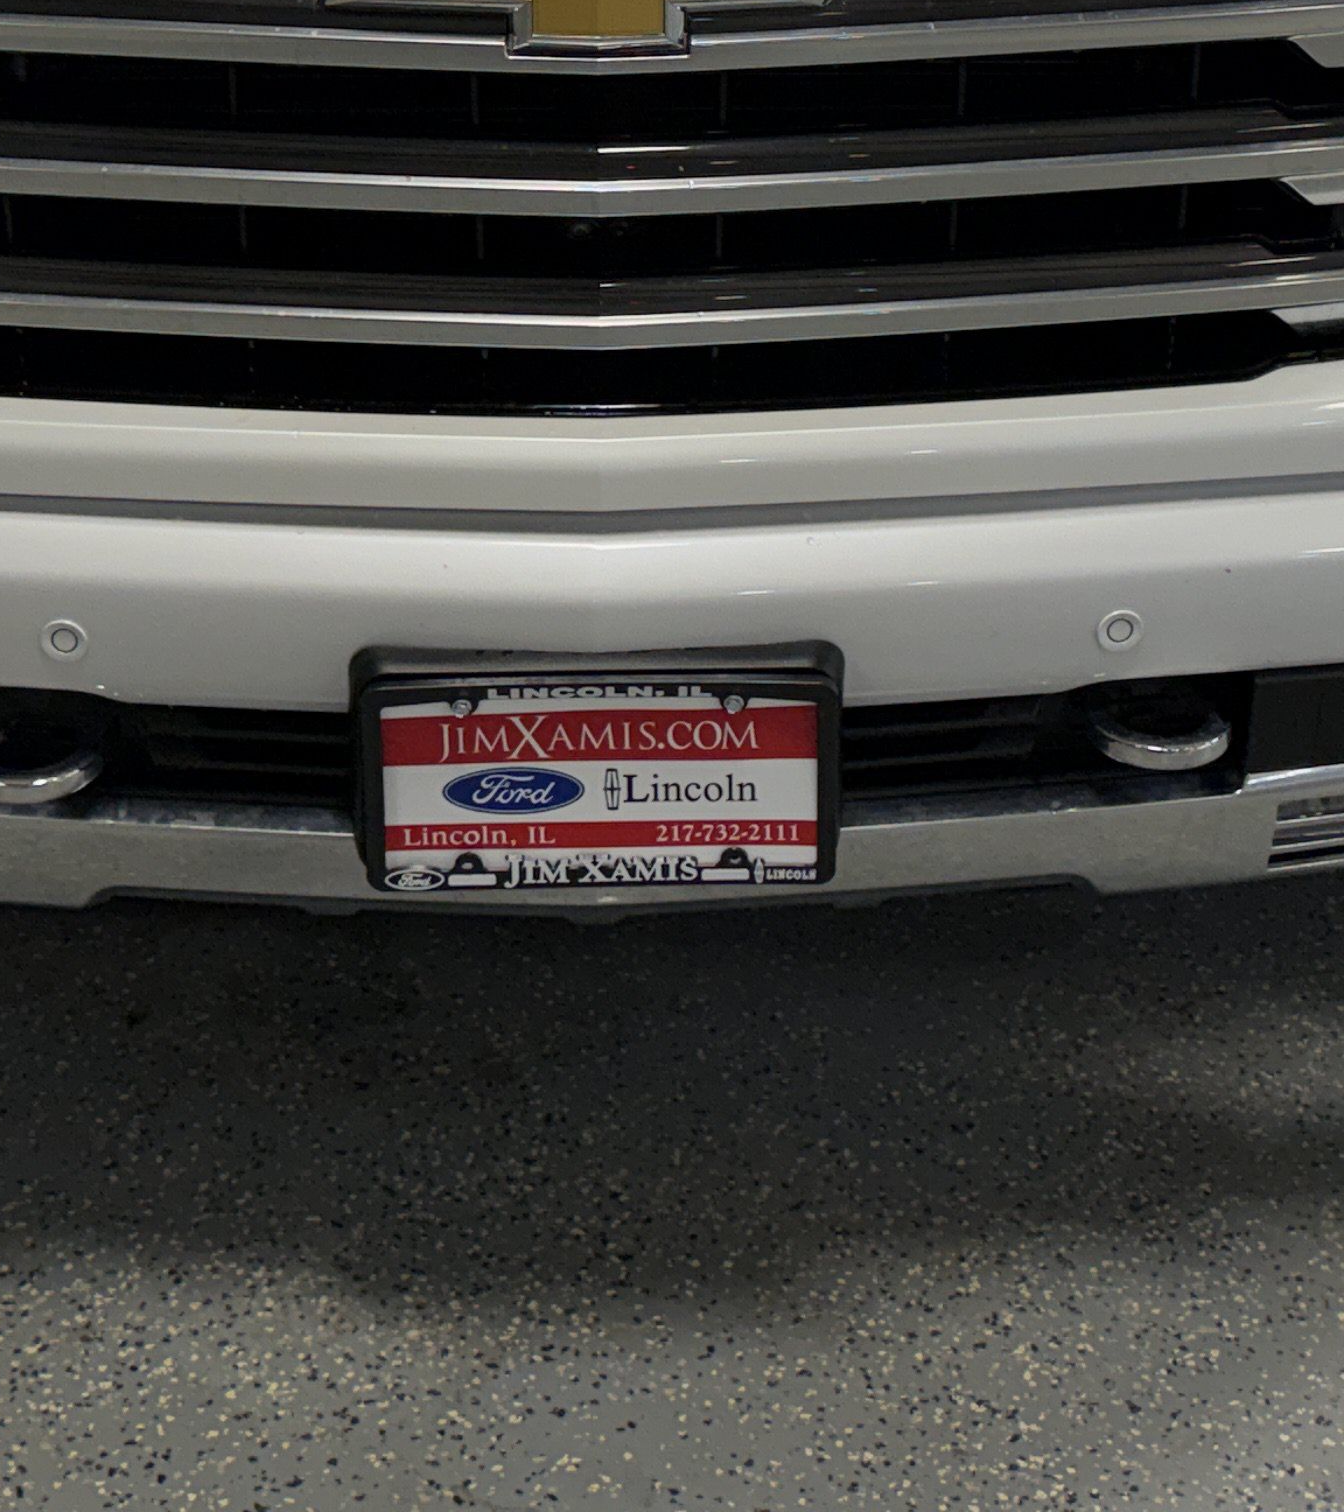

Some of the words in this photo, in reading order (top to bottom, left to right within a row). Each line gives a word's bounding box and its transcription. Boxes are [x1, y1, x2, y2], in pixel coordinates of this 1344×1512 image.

[678, 685, 712, 698] IL
[438, 715, 759, 764] JIMXAMIS.COM
[472, 774, 555, 806] Ford
[622, 773, 759, 805] Lincoln
[403, 825, 517, 847] Lincoln,
[528, 825, 557, 845] IL
[655, 823, 801, 843] 217-732-2111
[397, 873, 433, 888] Ford
[504, 854, 571, 889] JIM
[577, 854, 698, 885] XAMIS
[765, 868, 818, 881] LINCOLN
